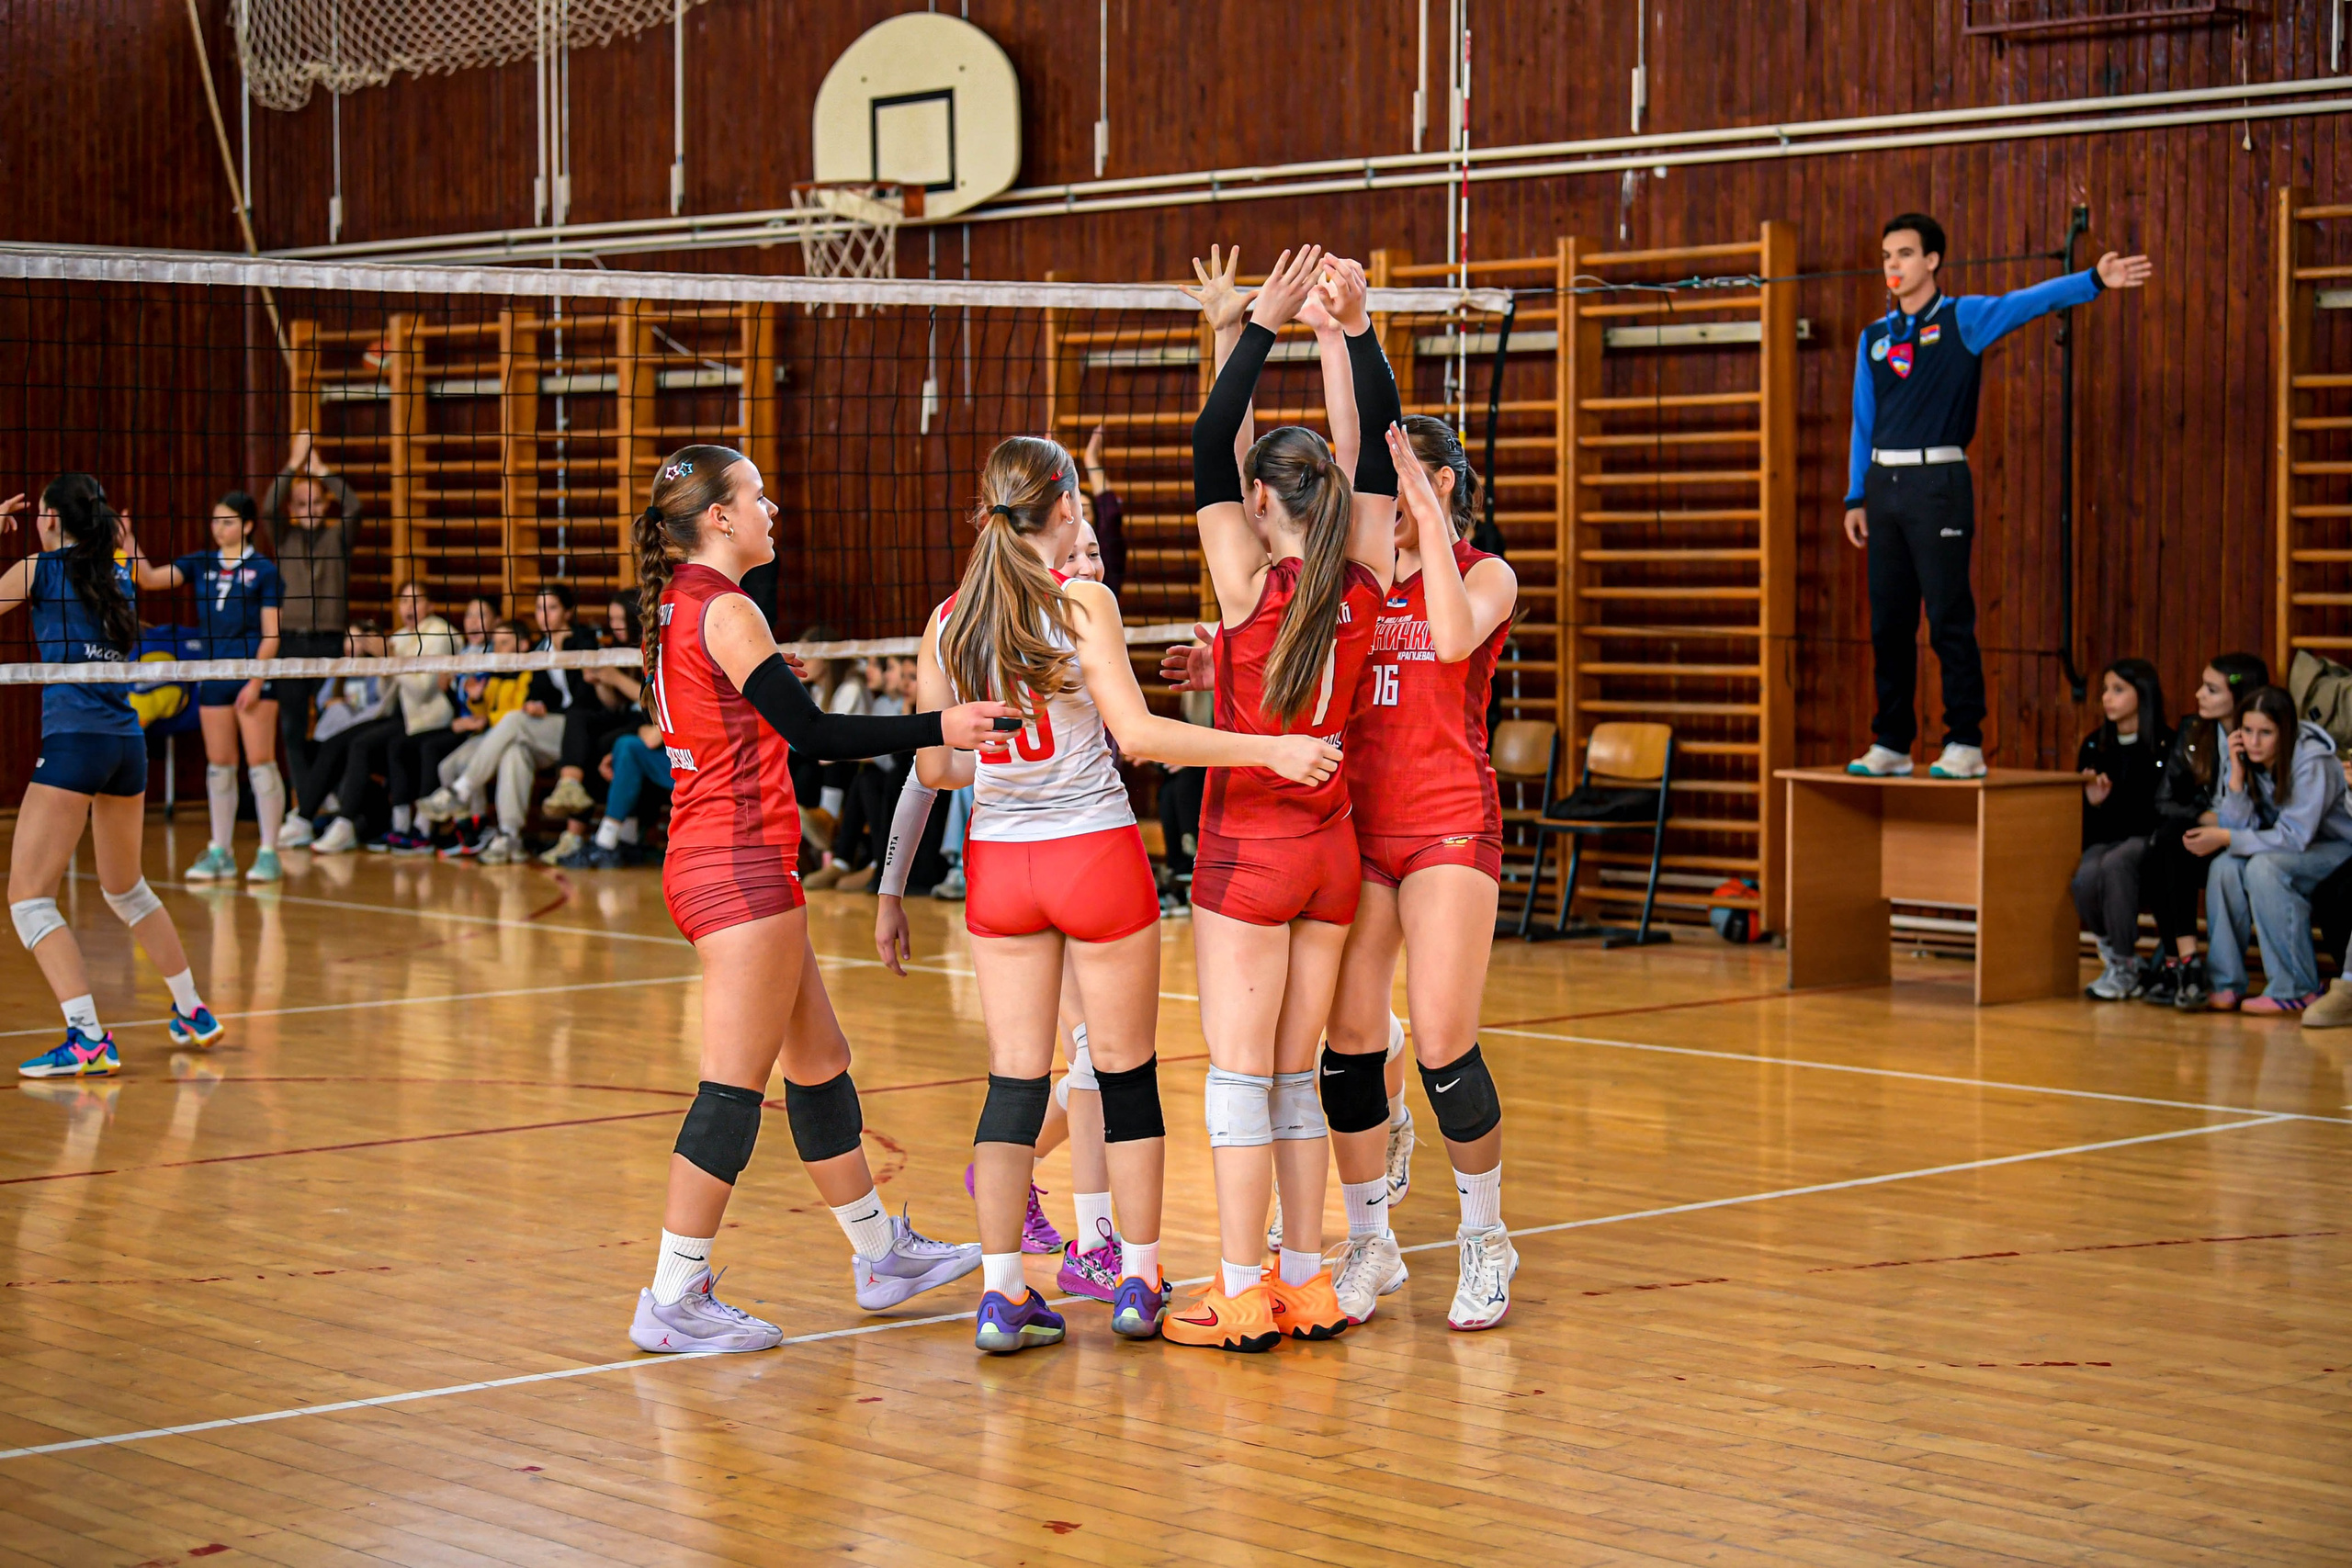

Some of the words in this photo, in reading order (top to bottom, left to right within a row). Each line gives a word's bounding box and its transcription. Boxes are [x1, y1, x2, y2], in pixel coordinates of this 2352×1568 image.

[215, 581, 232, 612] 7
[1373, 664, 1399, 706] 16
[886, 836, 899, 866] KIPSTA
